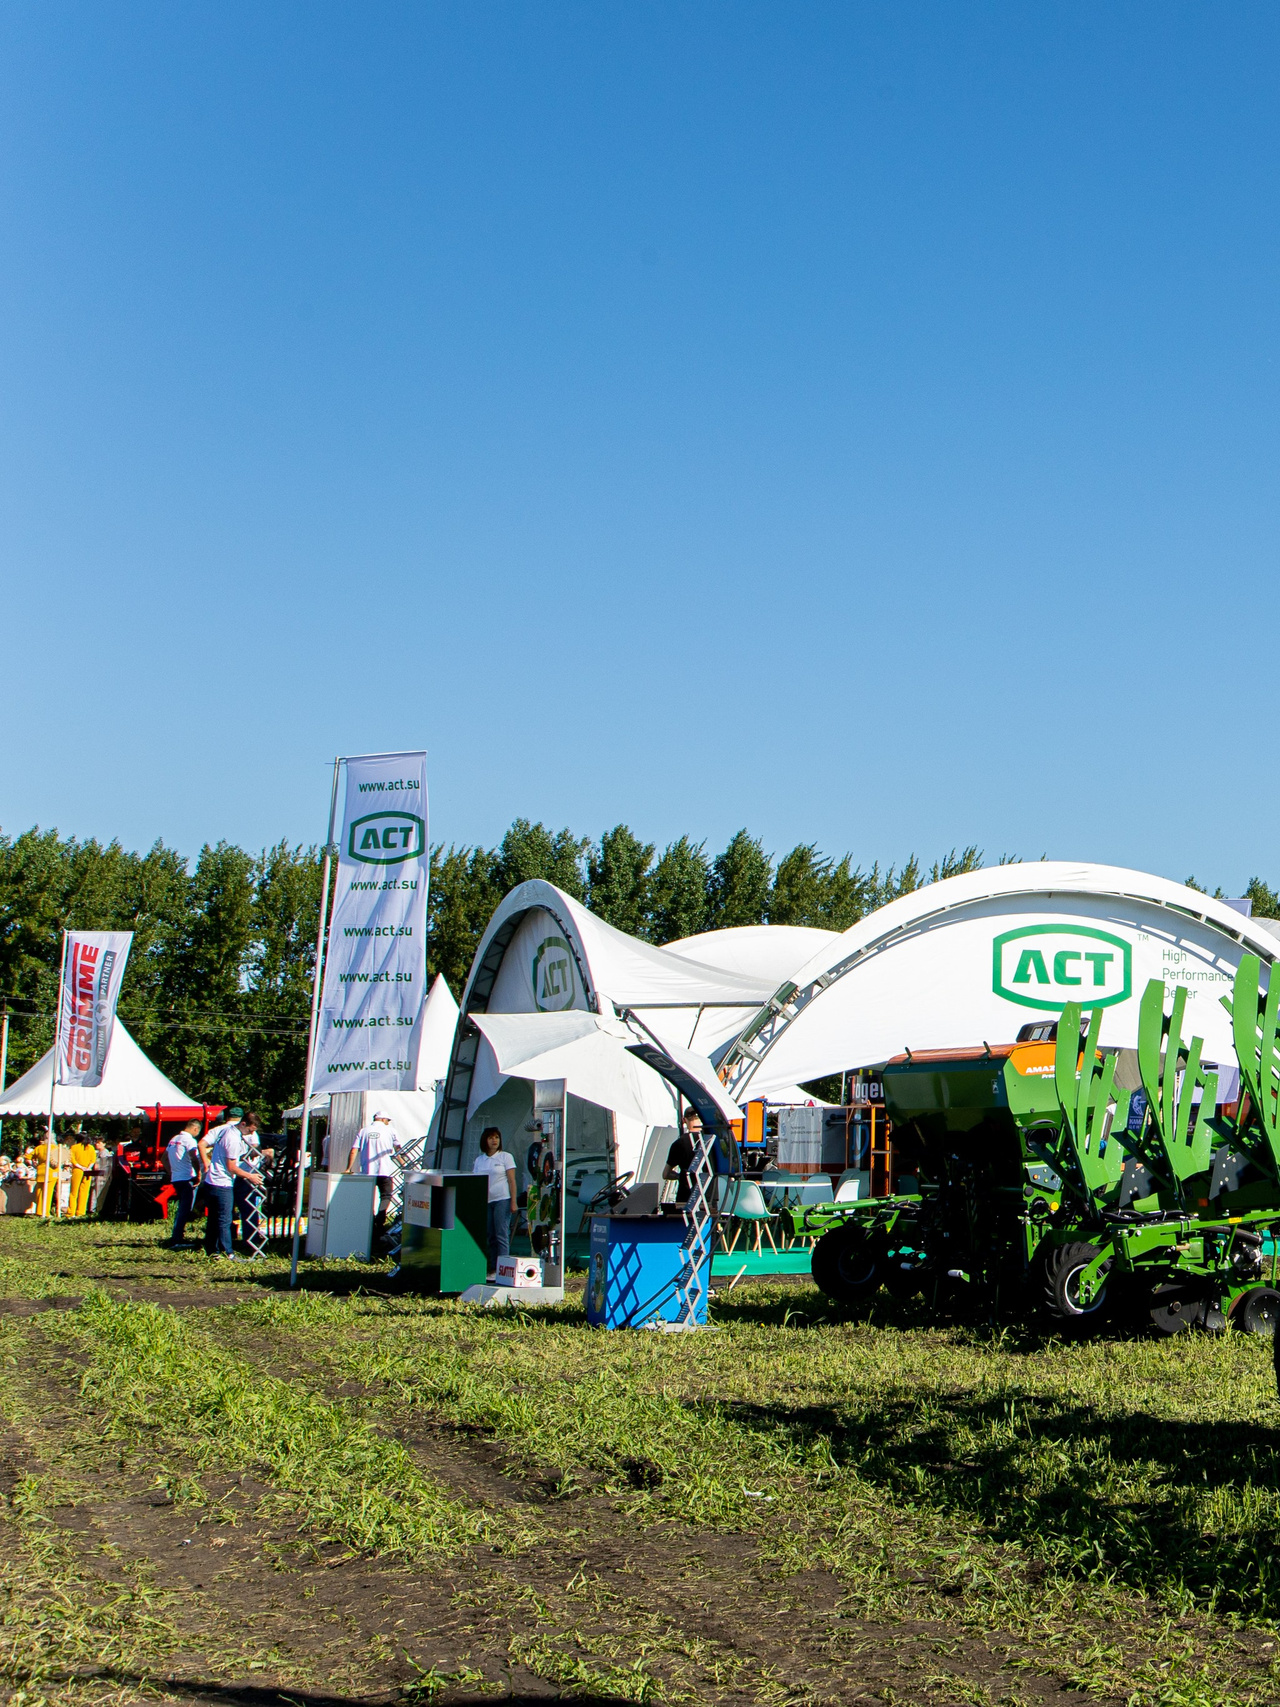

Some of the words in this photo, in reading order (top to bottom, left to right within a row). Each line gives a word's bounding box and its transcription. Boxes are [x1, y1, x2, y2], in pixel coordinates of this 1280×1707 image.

[359, 779, 420, 793] www.act.su
[360, 826, 414, 849] ACT
[350, 879, 418, 891] www.act.su
[344, 925, 413, 937] www.act.su
[1162, 949, 1187, 964] High
[1012, 949, 1114, 986] ACT
[100, 955, 113, 996] PARTNER
[339, 971, 412, 983] www.act.su
[541, 958, 568, 999] ACT
[1162, 968, 1234, 982] Performance
[1164, 986, 1198, 999] Deer
[332, 1015, 413, 1028] www.act.su
[97, 1030, 105, 1073] PREMIUM
[327, 1059, 412, 1073] www.act.su
[1025, 1064, 1056, 1074] AMAZ
